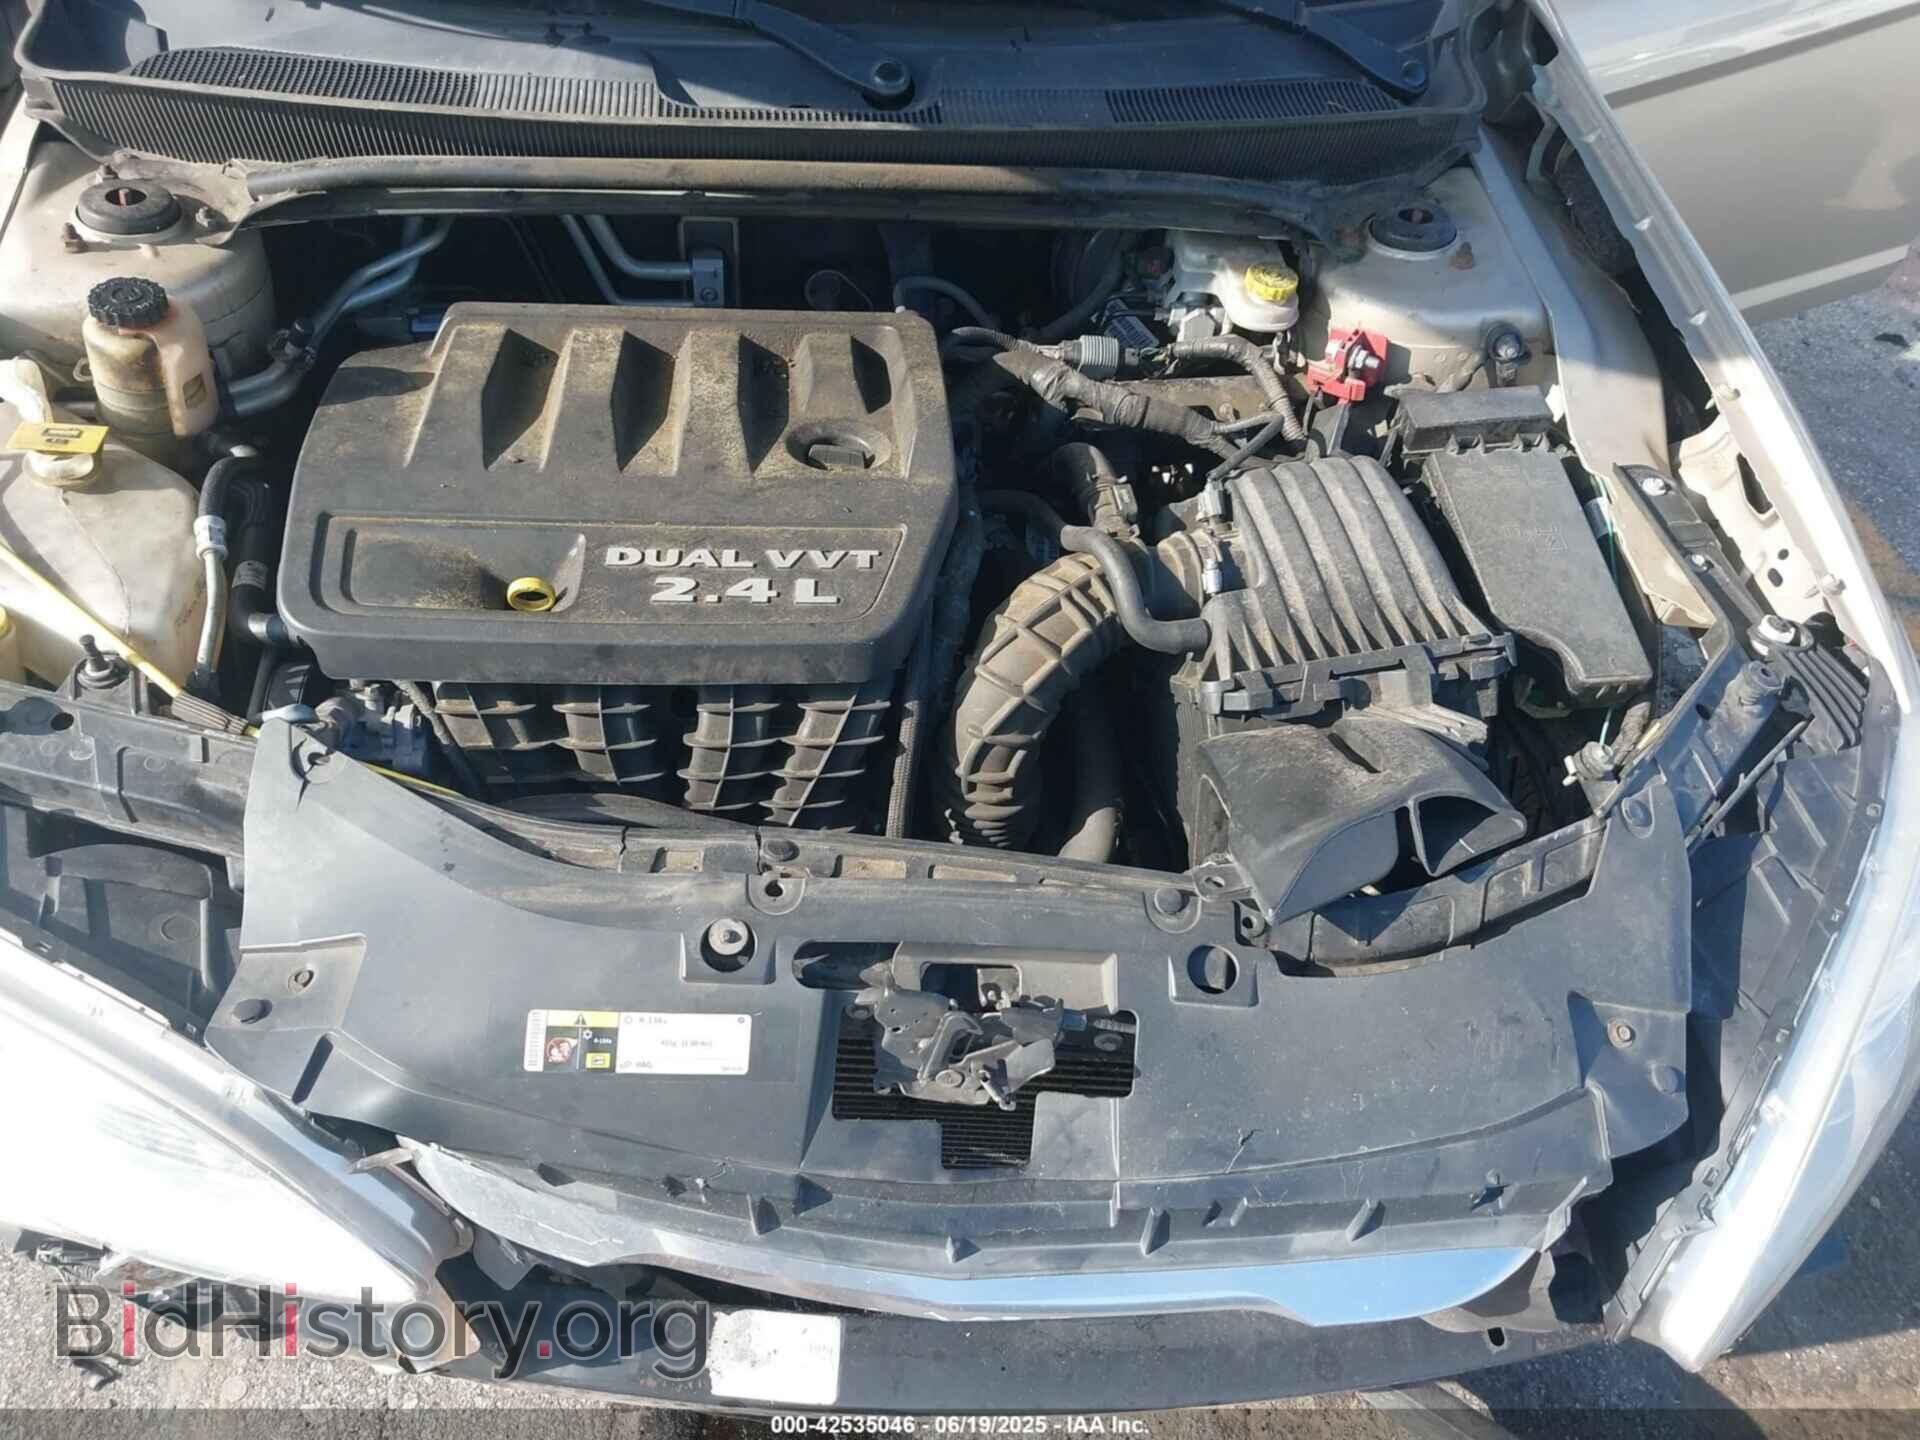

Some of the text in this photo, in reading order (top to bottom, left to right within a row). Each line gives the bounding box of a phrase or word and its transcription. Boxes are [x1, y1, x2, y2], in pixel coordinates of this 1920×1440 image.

[605, 546, 882, 569] DUAL VVT
[650, 576, 841, 605] 2.4 L
